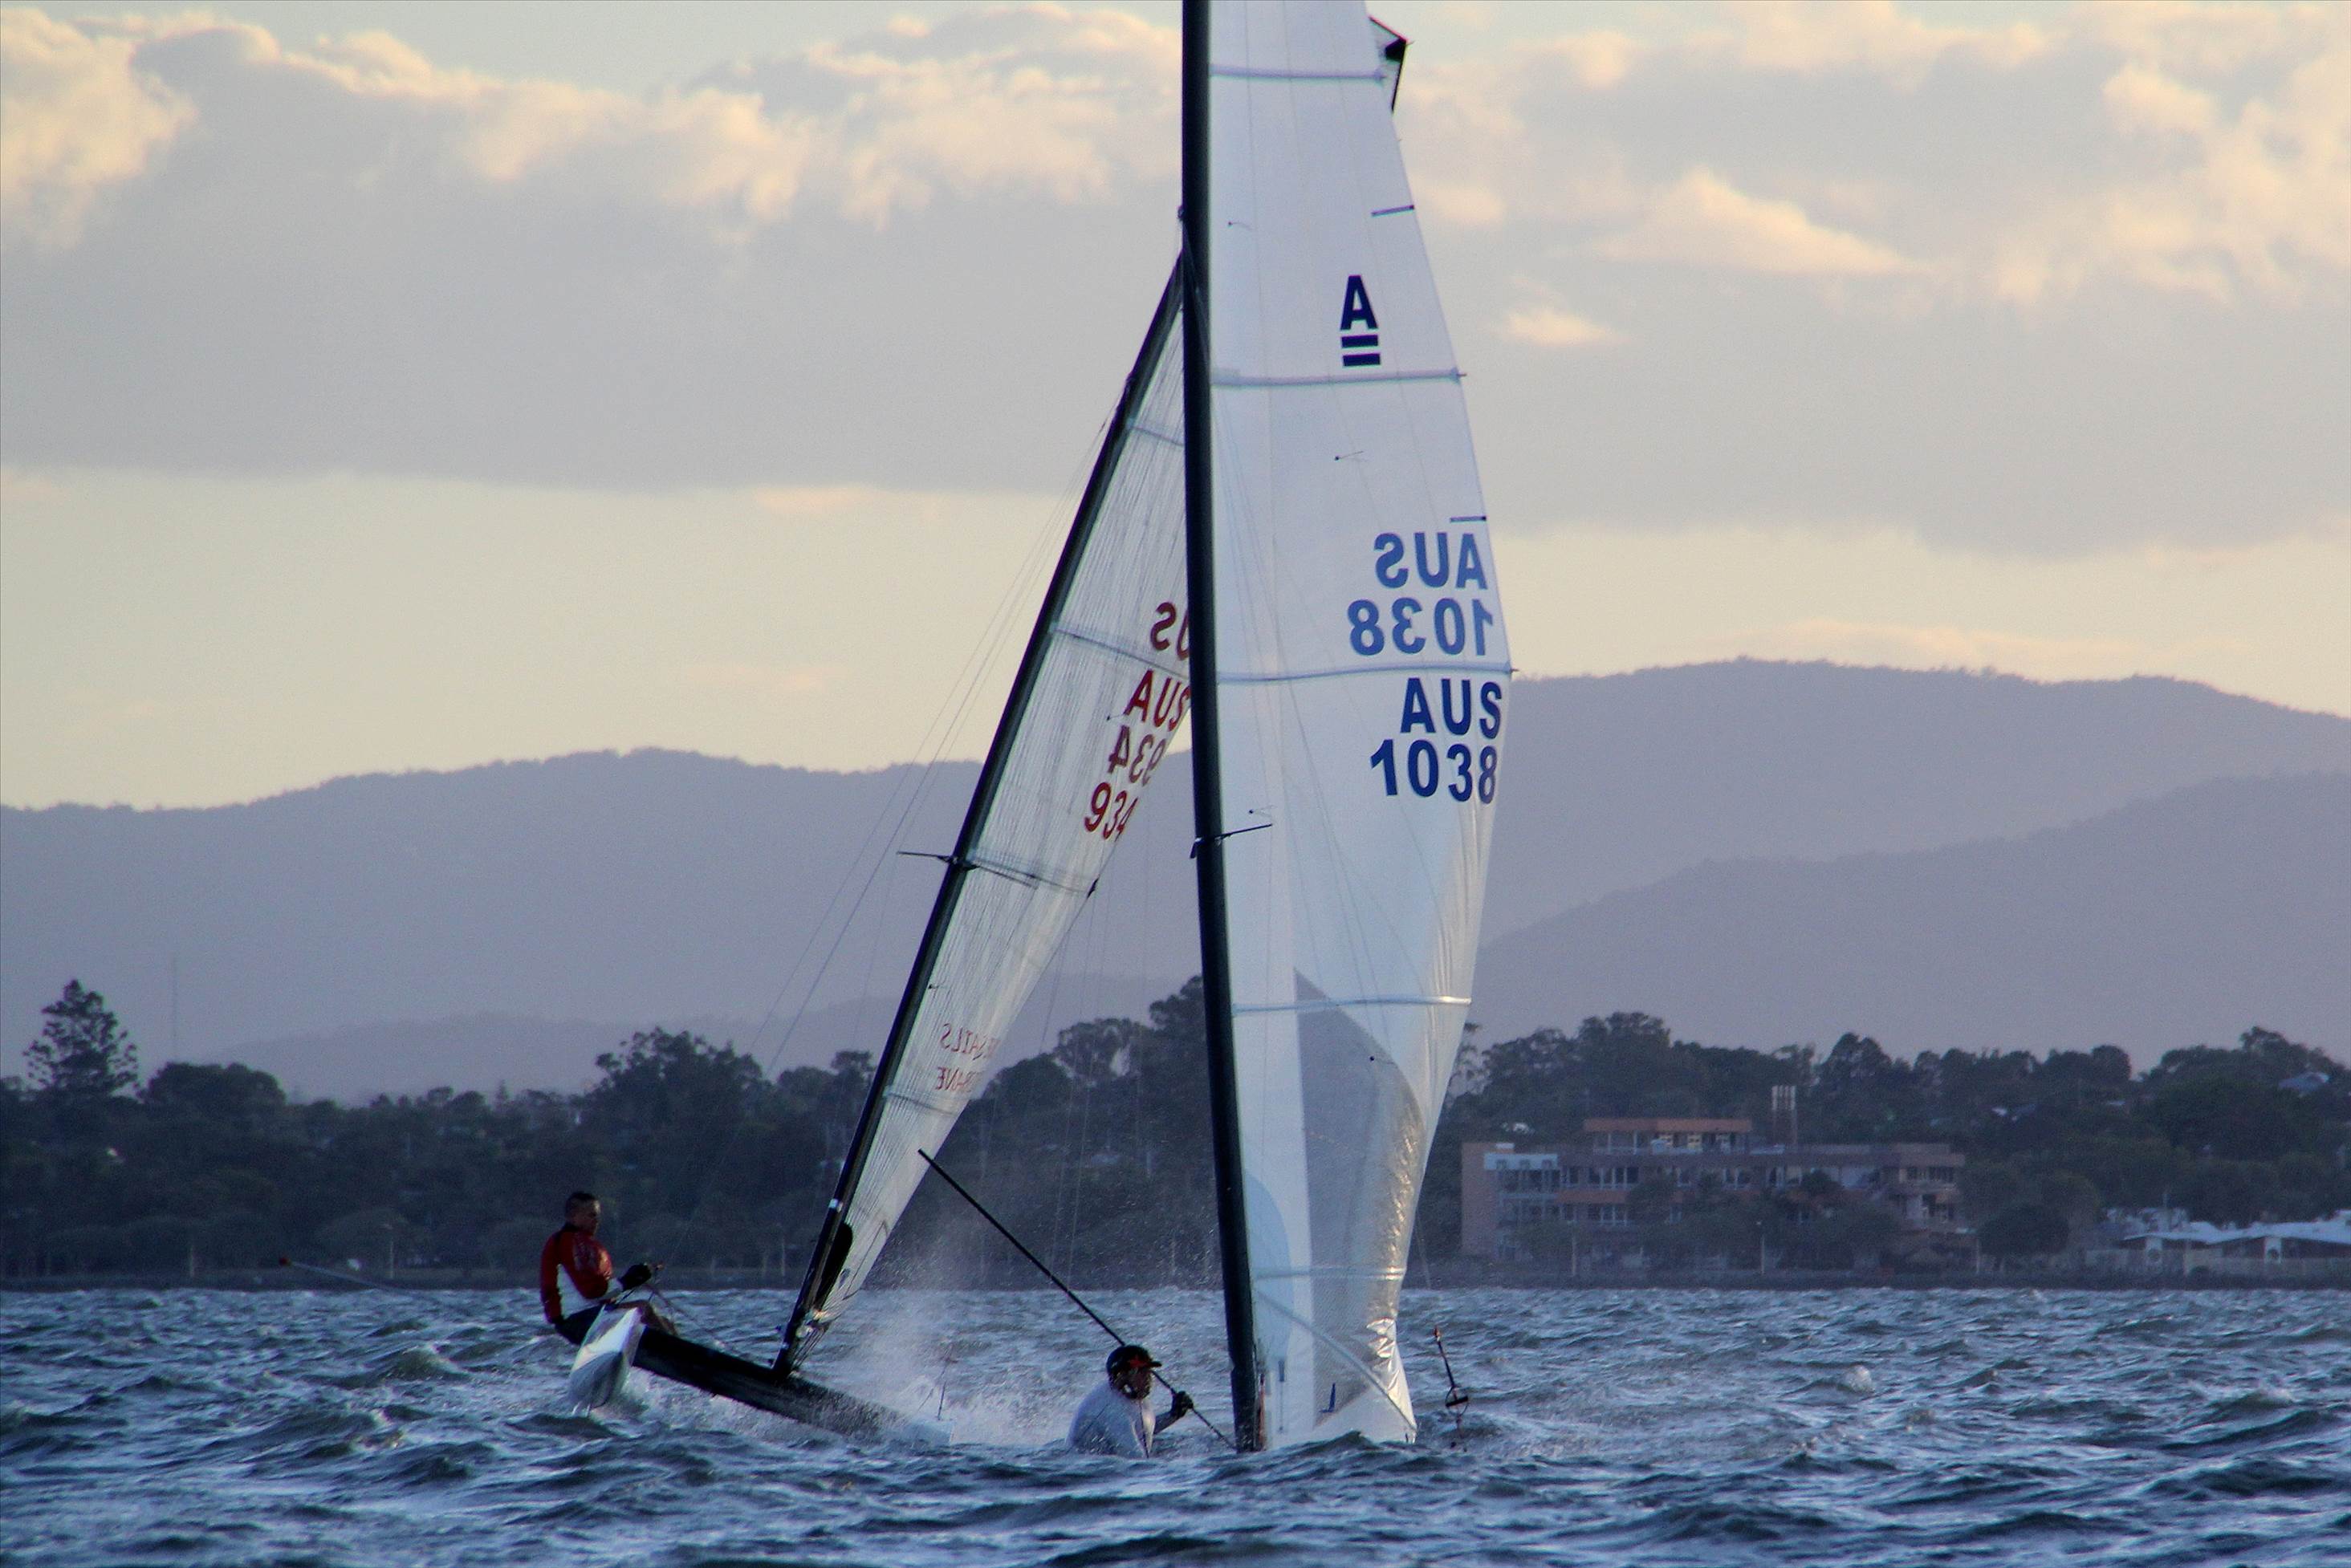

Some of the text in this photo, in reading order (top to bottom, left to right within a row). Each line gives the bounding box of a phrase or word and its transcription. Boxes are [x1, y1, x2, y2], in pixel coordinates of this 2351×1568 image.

[1340, 274, 1379, 330] A
[1124, 669, 1190, 732] AUS
[1400, 677, 1503, 741] AUS
[1369, 738, 1499, 805] 1038
